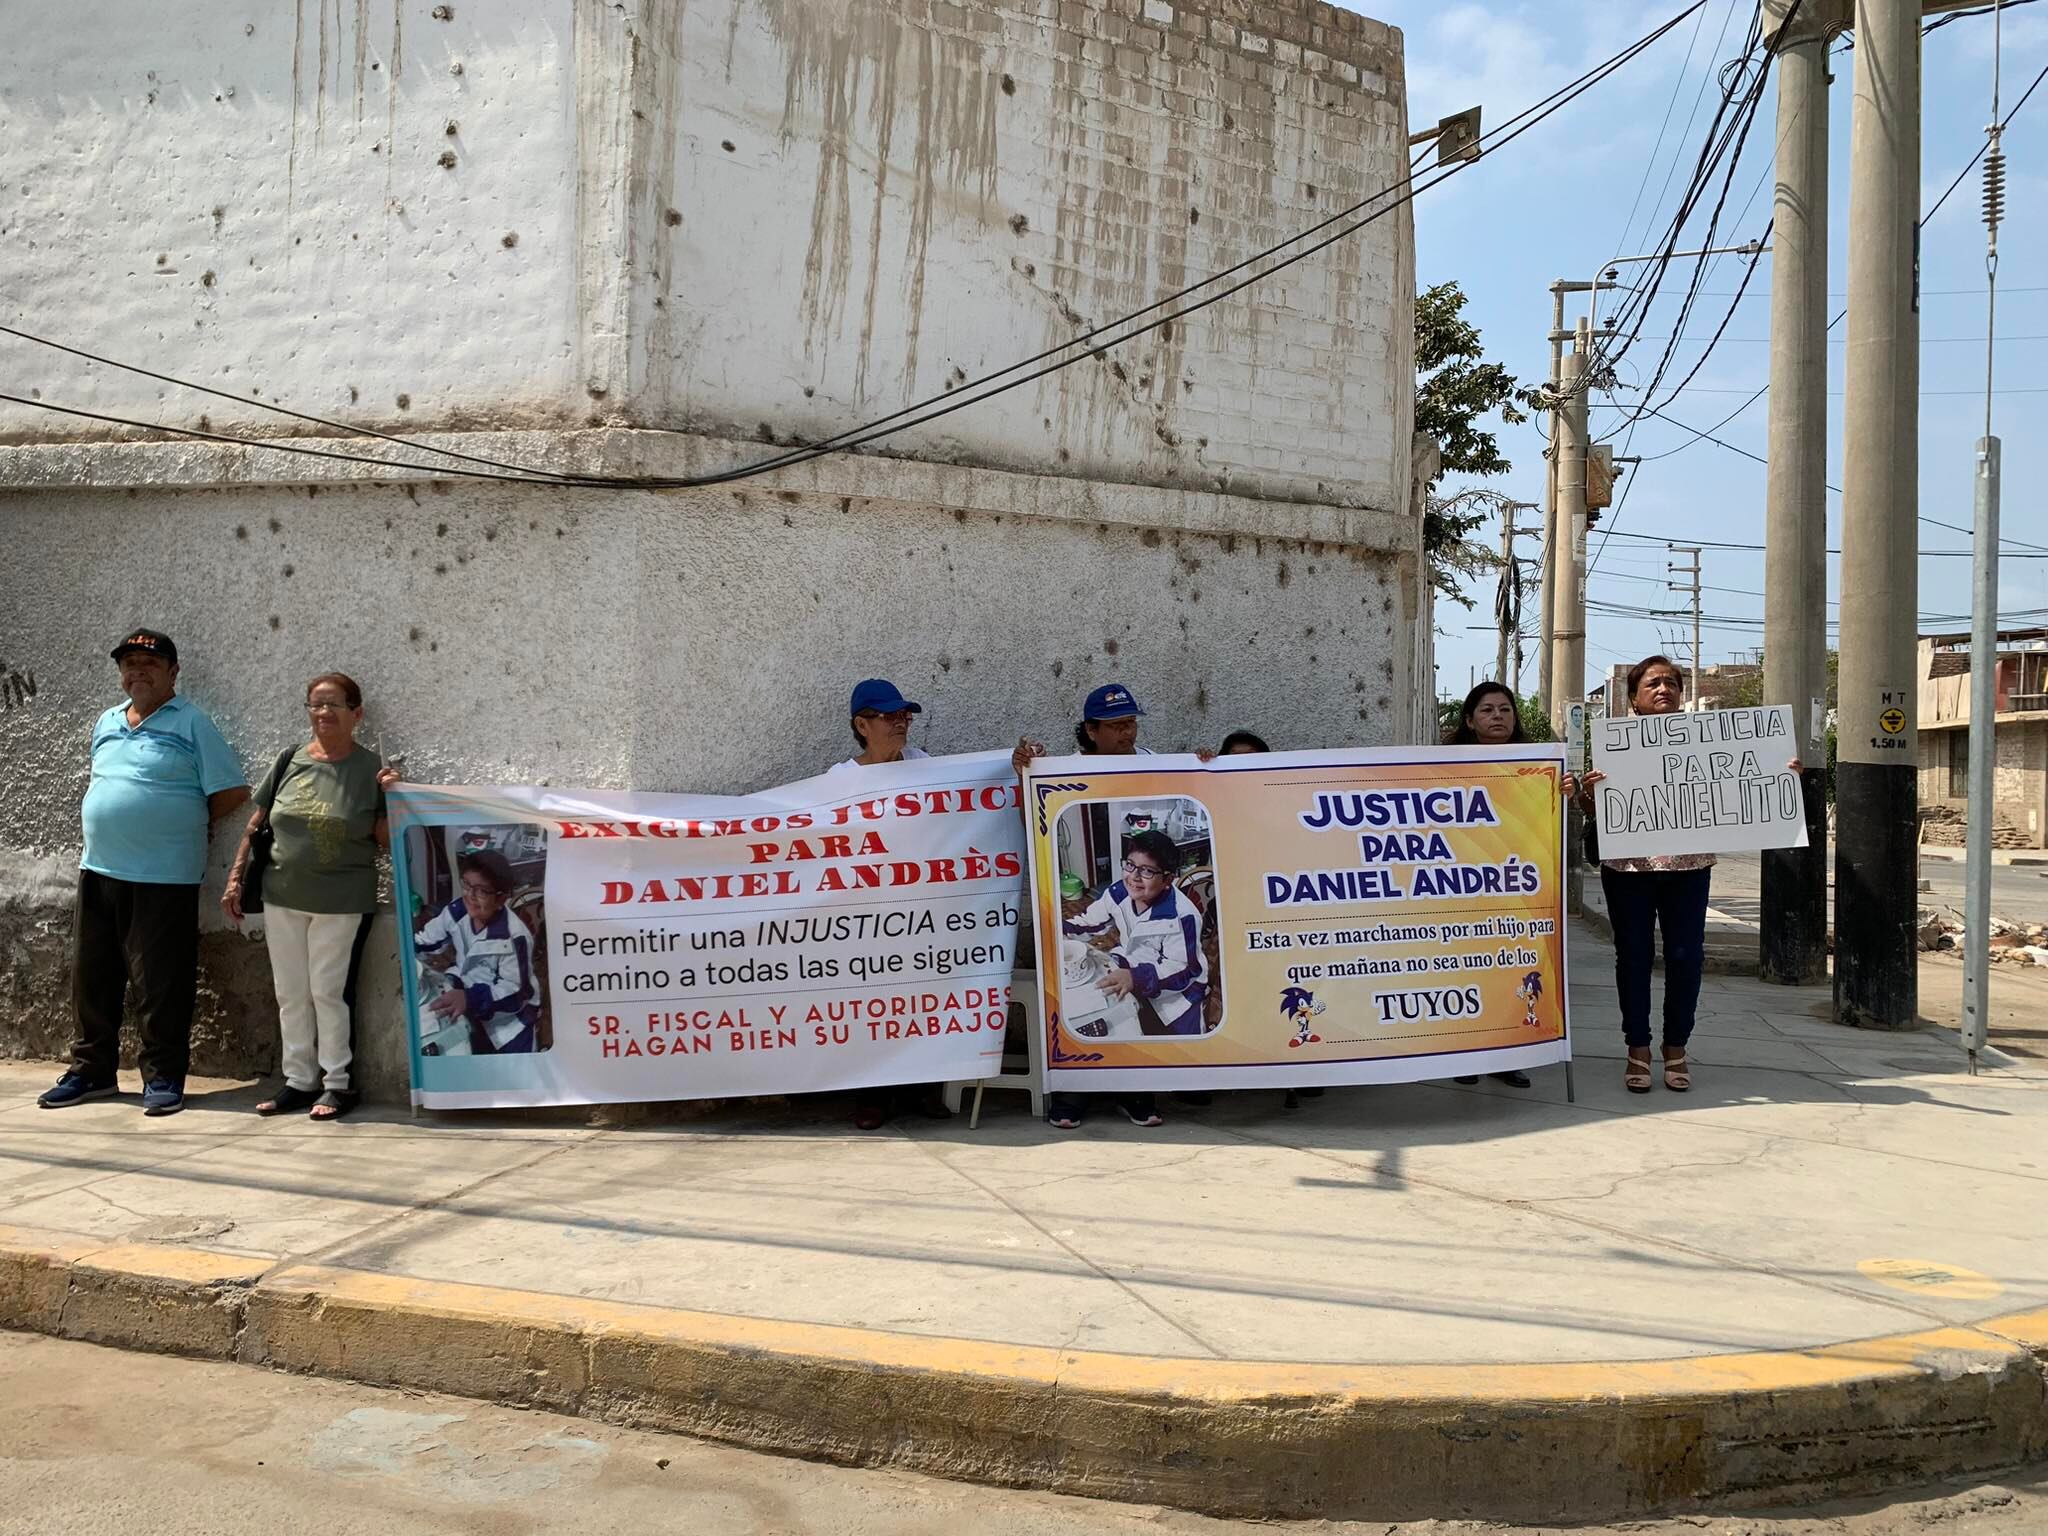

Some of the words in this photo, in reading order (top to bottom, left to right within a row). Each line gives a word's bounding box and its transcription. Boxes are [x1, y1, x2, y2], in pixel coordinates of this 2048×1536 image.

[1605, 710, 1786, 752] JUSTICIA
[1870, 737, 1895, 749] 1.50
[1897, 738, 1907, 749] M
[1663, 751, 1762, 784] PARA
[1303, 790, 1496, 827] JUSTICIA
[1604, 772, 1799, 834] DANIELITO
[554, 813, 813, 839] EXIGIMOS
[747, 830, 889, 865] PARA
[1361, 833, 1451, 863] PARA
[600, 870, 800, 904] DANIEL
[816, 847, 1021, 892] ANDRÈS
[1267, 870, 1402, 904] DANIEL
[1413, 858, 1538, 897] ANDRÉS
[563, 929, 679, 956] Permitir
[692, 928, 745, 950] una
[757, 910, 936, 946] INJUSTICIA
[946, 912, 976, 931] es
[986, 903, 1019, 928] ab
[1248, 930, 1291, 950] Esta
[1298, 931, 1330, 947] vez
[1335, 922, 1437, 943] marchamos
[1442, 925, 1470, 945] por
[1473, 919, 1494, 936] mi
[1496, 915, 1525, 940] hijo
[1529, 919, 1555, 939] para
[563, 965, 669, 993] camino
[680, 968, 696, 987] a
[706, 958, 788, 985] todas
[799, 954, 839, 979] las
[849, 955, 903, 981] que
[913, 943, 1005, 974] siguen
[1287, 963, 1322, 984] que
[1327, 957, 1401, 978] mañana
[1407, 957, 1429, 972] no
[1434, 956, 1460, 970] sea
[1463, 955, 1492, 968] uno
[1497, 949, 1516, 966] de
[1518, 948, 1537, 965] los
[588, 1015, 630, 1036] SR.
[648, 1008, 751, 1034] FISCAL
[768, 1006, 787, 1026] Y
[1375, 988, 1481, 1021] TUYOS
[602, 1033, 712, 1058] HAGAN
[730, 1028, 797, 1052] BIEN
[816, 1024, 849, 1046] SU
[867, 1010, 1005, 1041] TRABAJO
